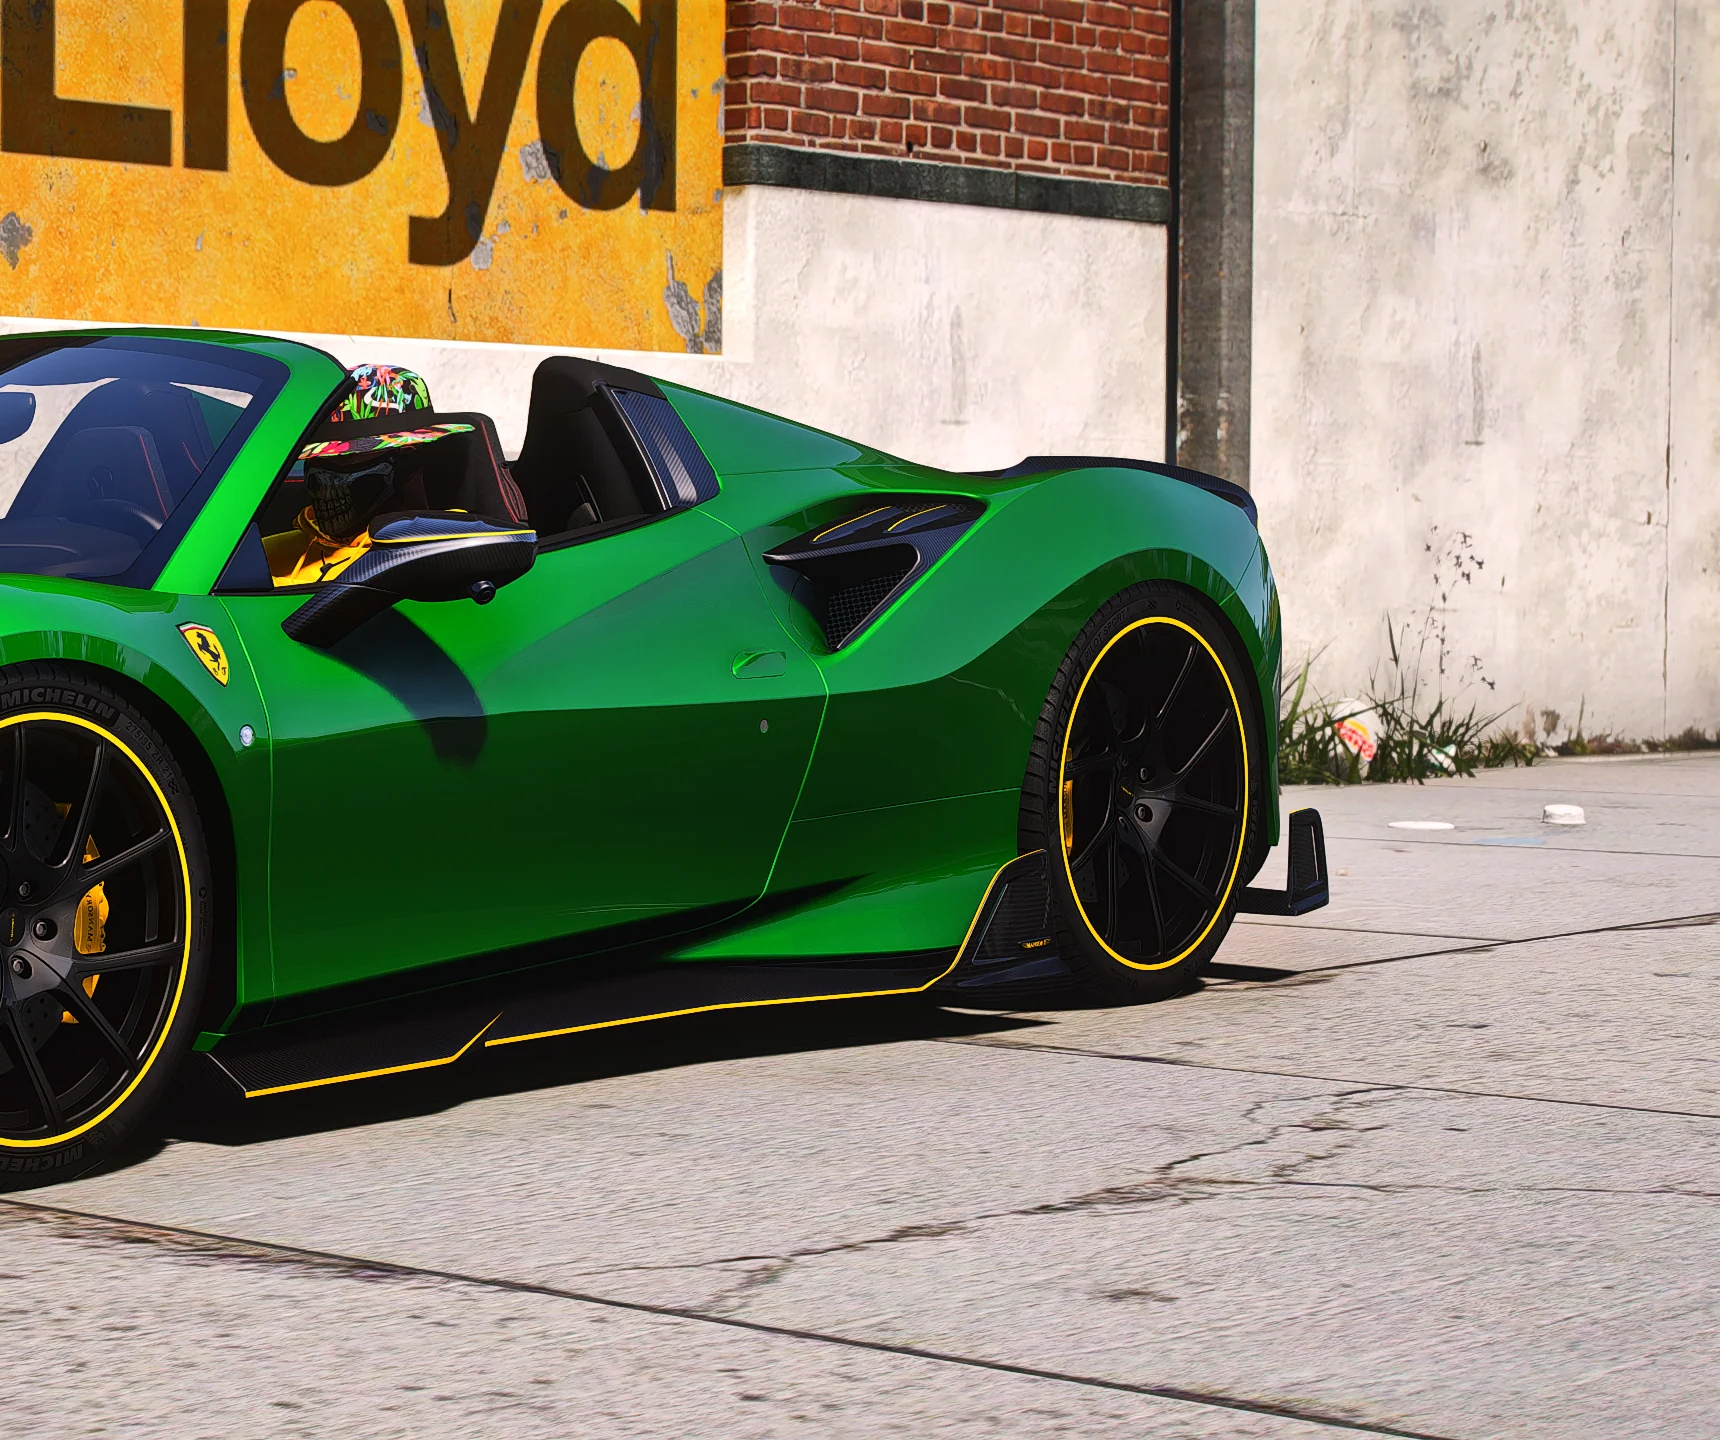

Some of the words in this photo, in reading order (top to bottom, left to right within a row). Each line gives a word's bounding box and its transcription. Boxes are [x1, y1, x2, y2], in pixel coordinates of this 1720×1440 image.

[0, 688, 117, 720] MICHELIN
[1049, 665, 1082, 794] MICHELIN
[125, 721, 153, 750] 275/35
[151, 750, 164, 766] ZR
[162, 765, 173, 779] 21
